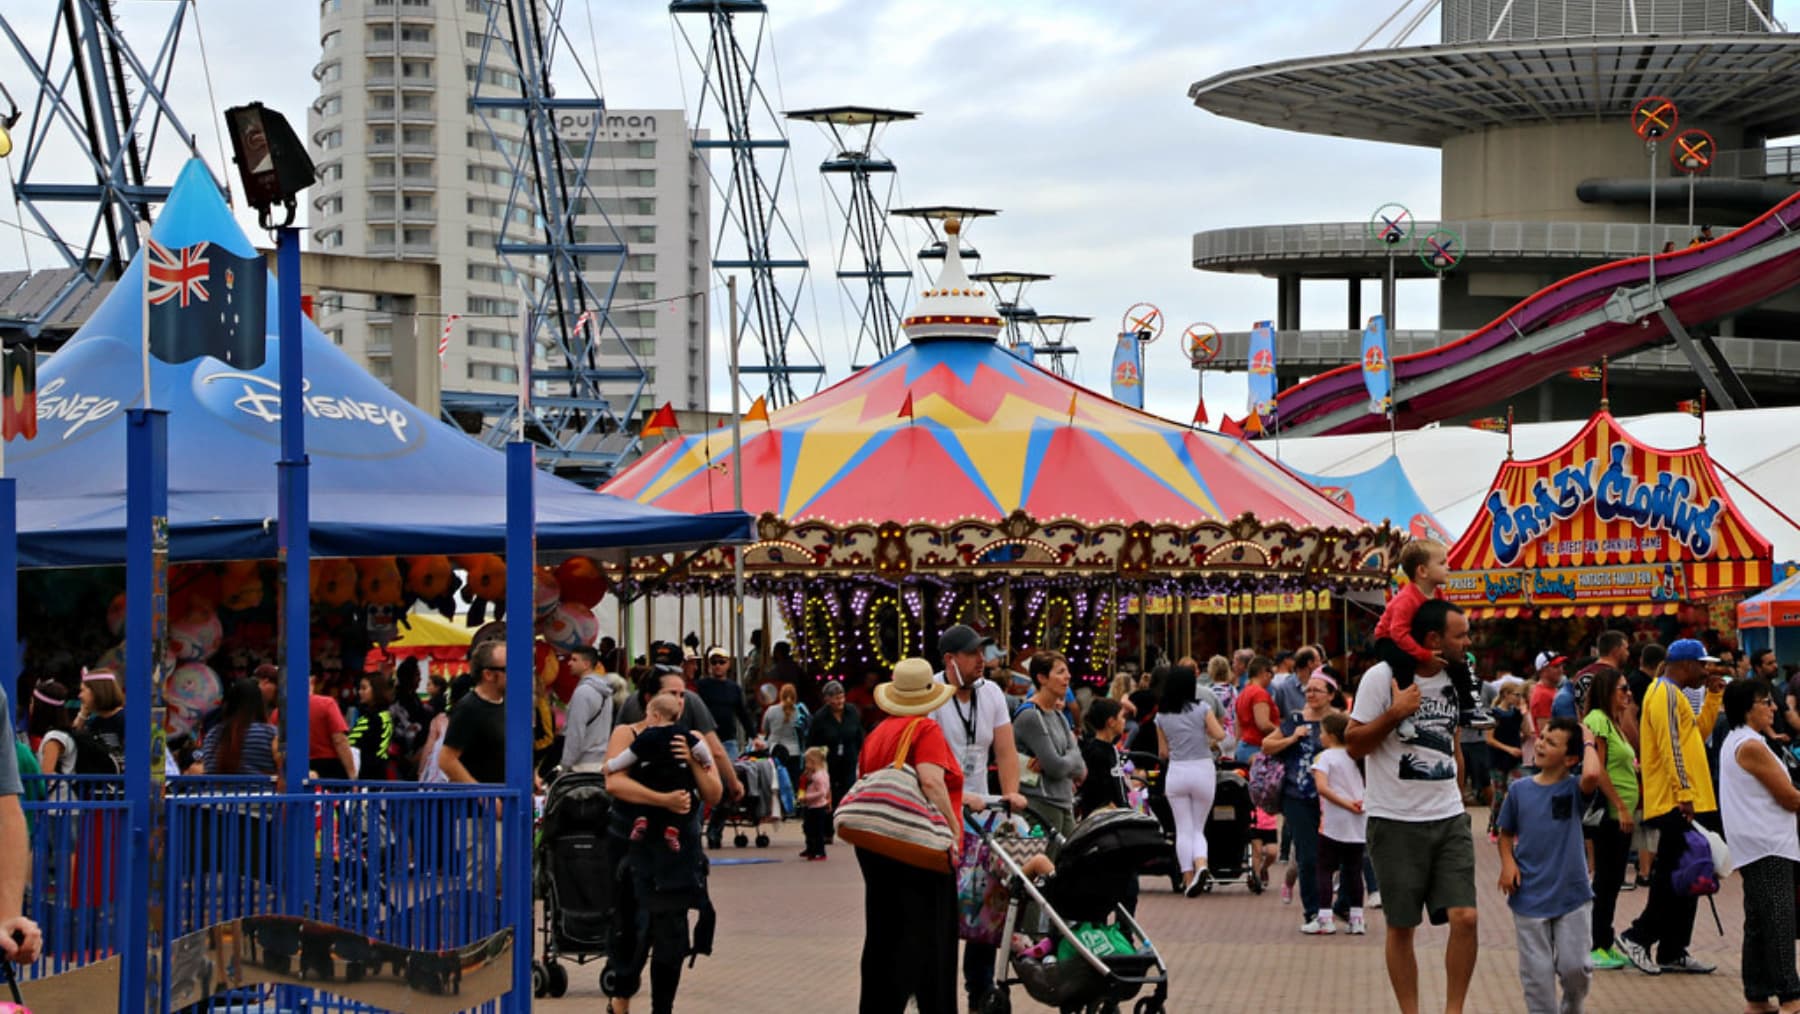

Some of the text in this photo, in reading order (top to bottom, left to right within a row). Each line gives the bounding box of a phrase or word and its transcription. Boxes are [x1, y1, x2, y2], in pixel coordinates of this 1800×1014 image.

[1487, 443, 1724, 566] CRAZY CLOWNS
[1542, 541, 1556, 555] THE
[1640, 536, 1662, 551] GAME
